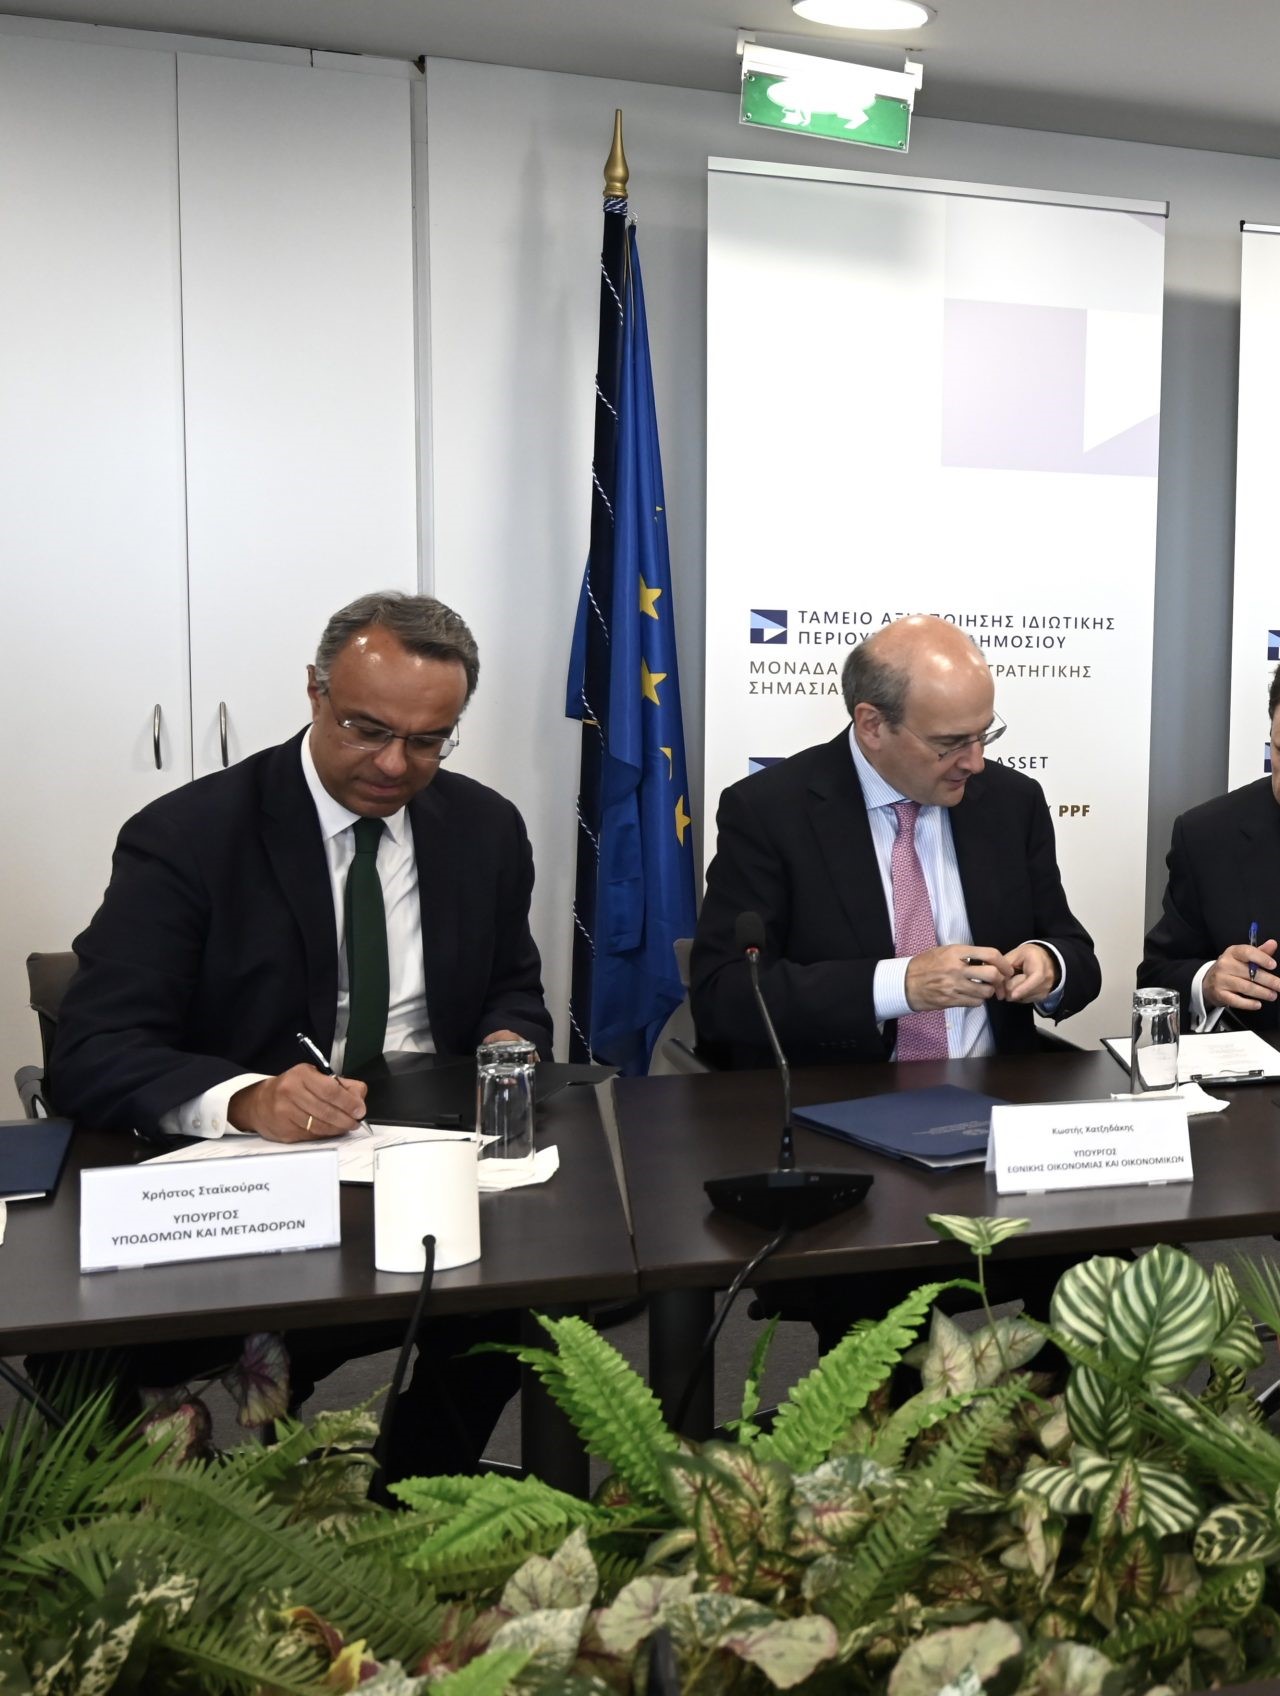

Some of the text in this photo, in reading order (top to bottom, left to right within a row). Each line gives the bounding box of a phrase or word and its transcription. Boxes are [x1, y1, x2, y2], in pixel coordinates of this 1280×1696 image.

[798, 610, 1115, 631] ΤΑΜΕΙΟ ΑΟΙΗΣΗΣ ΙΔΙΩΤΙΚΗΣ
[798, 631, 876, 646] ΠΕΡΙΟΥ
[749, 660, 1091, 678] ΜΟΝΑΔΑ ΡΑΤΗΓΙΚΗΣ
[748, 680, 844, 696] ΣΗΜΑΣΙΑ
[995, 756, 1048, 769] ASSET
[1058, 804, 1090, 817] PPF
[1052, 1123, 1135, 1136] Κωστής Χατζηδάκης
[1073, 1148, 1117, 1158] ΥΠΟΥΡΓΟΣ
[1007, 1155, 1185, 1174] ΕΘΝΙΚΗΣ ΟΙΚΟΝΟΜΙΑΣ ΚΑΙ ΟΙΚΟΝΟΜΙΚΩΝ
[141, 1181, 270, 1202] Χρήστος Σταϊκούρας
[173, 1209, 240, 1225] ΥΠΟΥΡΓΟΣ
[111, 1219, 306, 1247] ΥΠΟΔΟΜΩΝ ΚΑΙ ΜΕΤΑΦΟΡΩΝ
